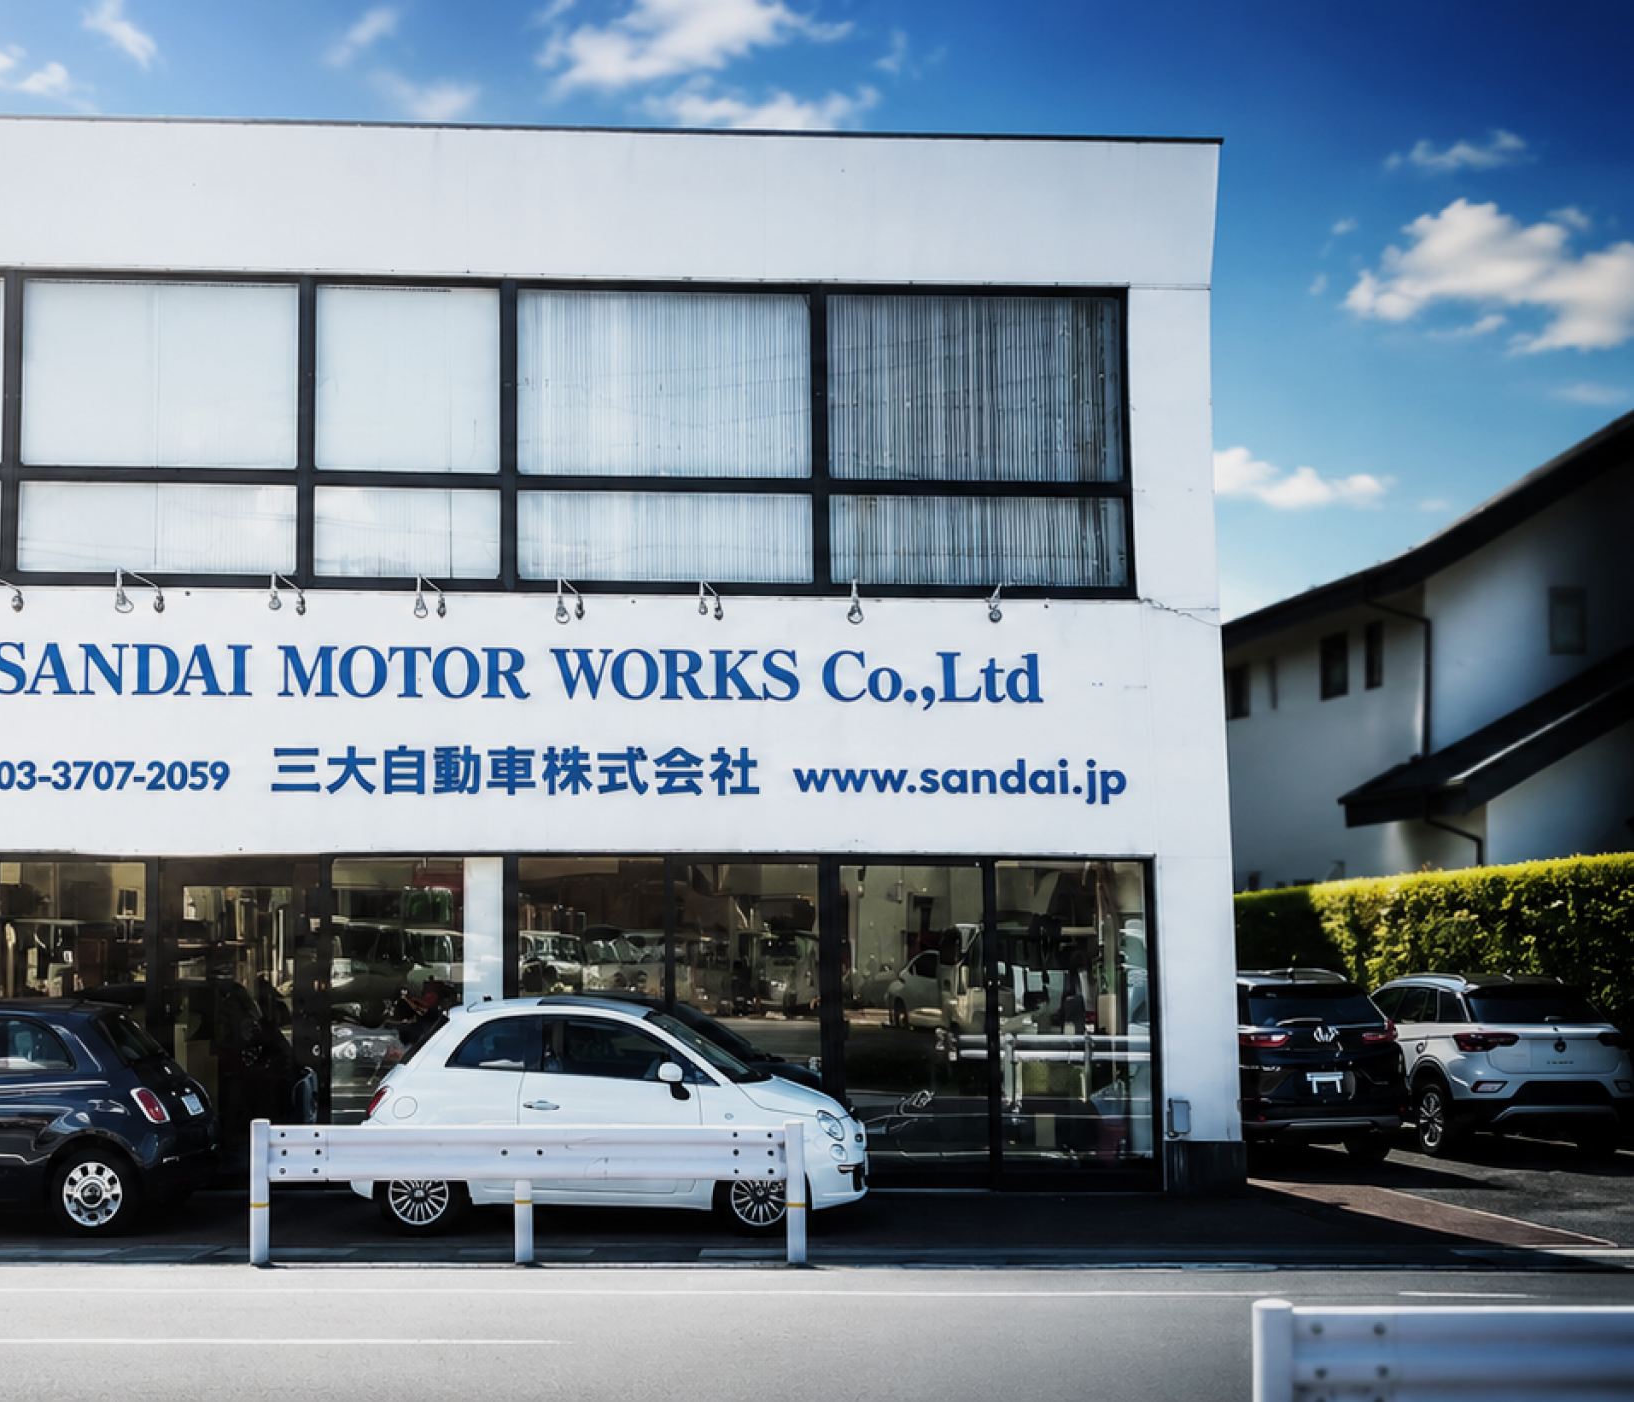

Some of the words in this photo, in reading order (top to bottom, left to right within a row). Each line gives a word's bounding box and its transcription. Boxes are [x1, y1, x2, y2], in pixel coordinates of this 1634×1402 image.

[277, 644, 530, 699] MOTOR
[550, 647, 800, 702] WORKS
[270, 744, 760, 796] 三大自動車株式会社
[792, 758, 1127, 805] www.sandai.jp
